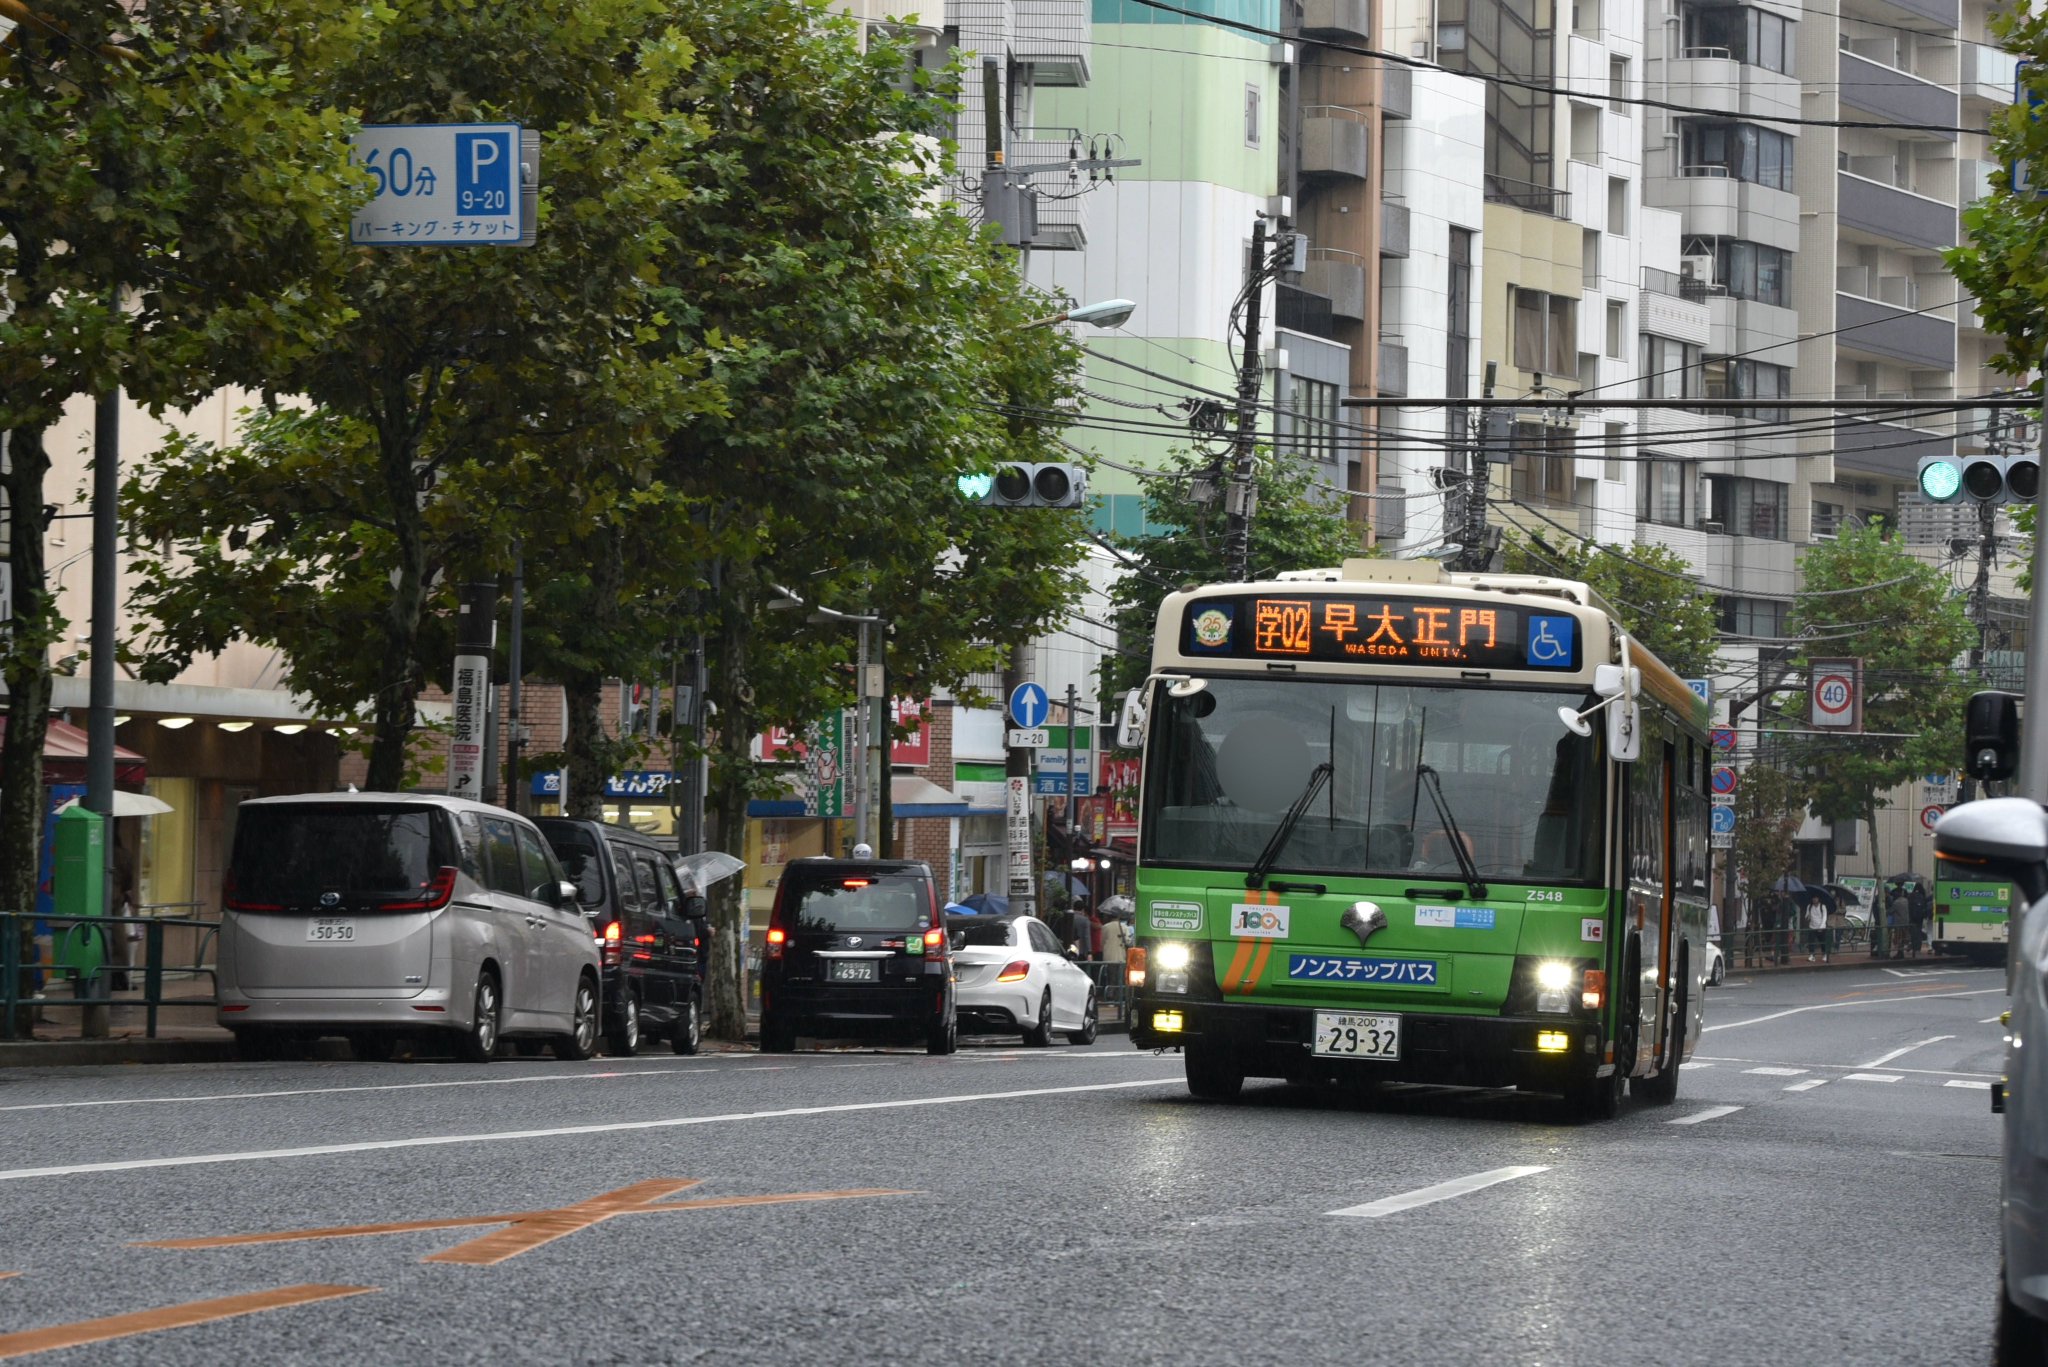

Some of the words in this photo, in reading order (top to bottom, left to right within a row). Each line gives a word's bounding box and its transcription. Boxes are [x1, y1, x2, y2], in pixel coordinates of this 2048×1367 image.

[471, 138, 499, 185] P
[364, 147, 437, 197] 60分
[461, 190, 505, 210] 9-20
[1320, 603, 1496, 648] 早大正門
[1345, 643, 1408, 656] WASEDA
[1419, 647, 1468, 659] UNIV.
[1823, 685, 1845, 703] 40
[454, 667, 475, 742] 福島医院
[1014, 732, 1044, 745] 7-20
[1040, 755, 1087, 766] Familyart
[1057, 780, 1086, 793] たこ
[1526, 889, 1564, 902] Z548
[317, 926, 354, 939] 50-50
[841, 969, 871, 980] 69-72
[1290, 957, 1436, 982] ノンステップバス
[1328, 1027, 1396, 1055] 29-32
